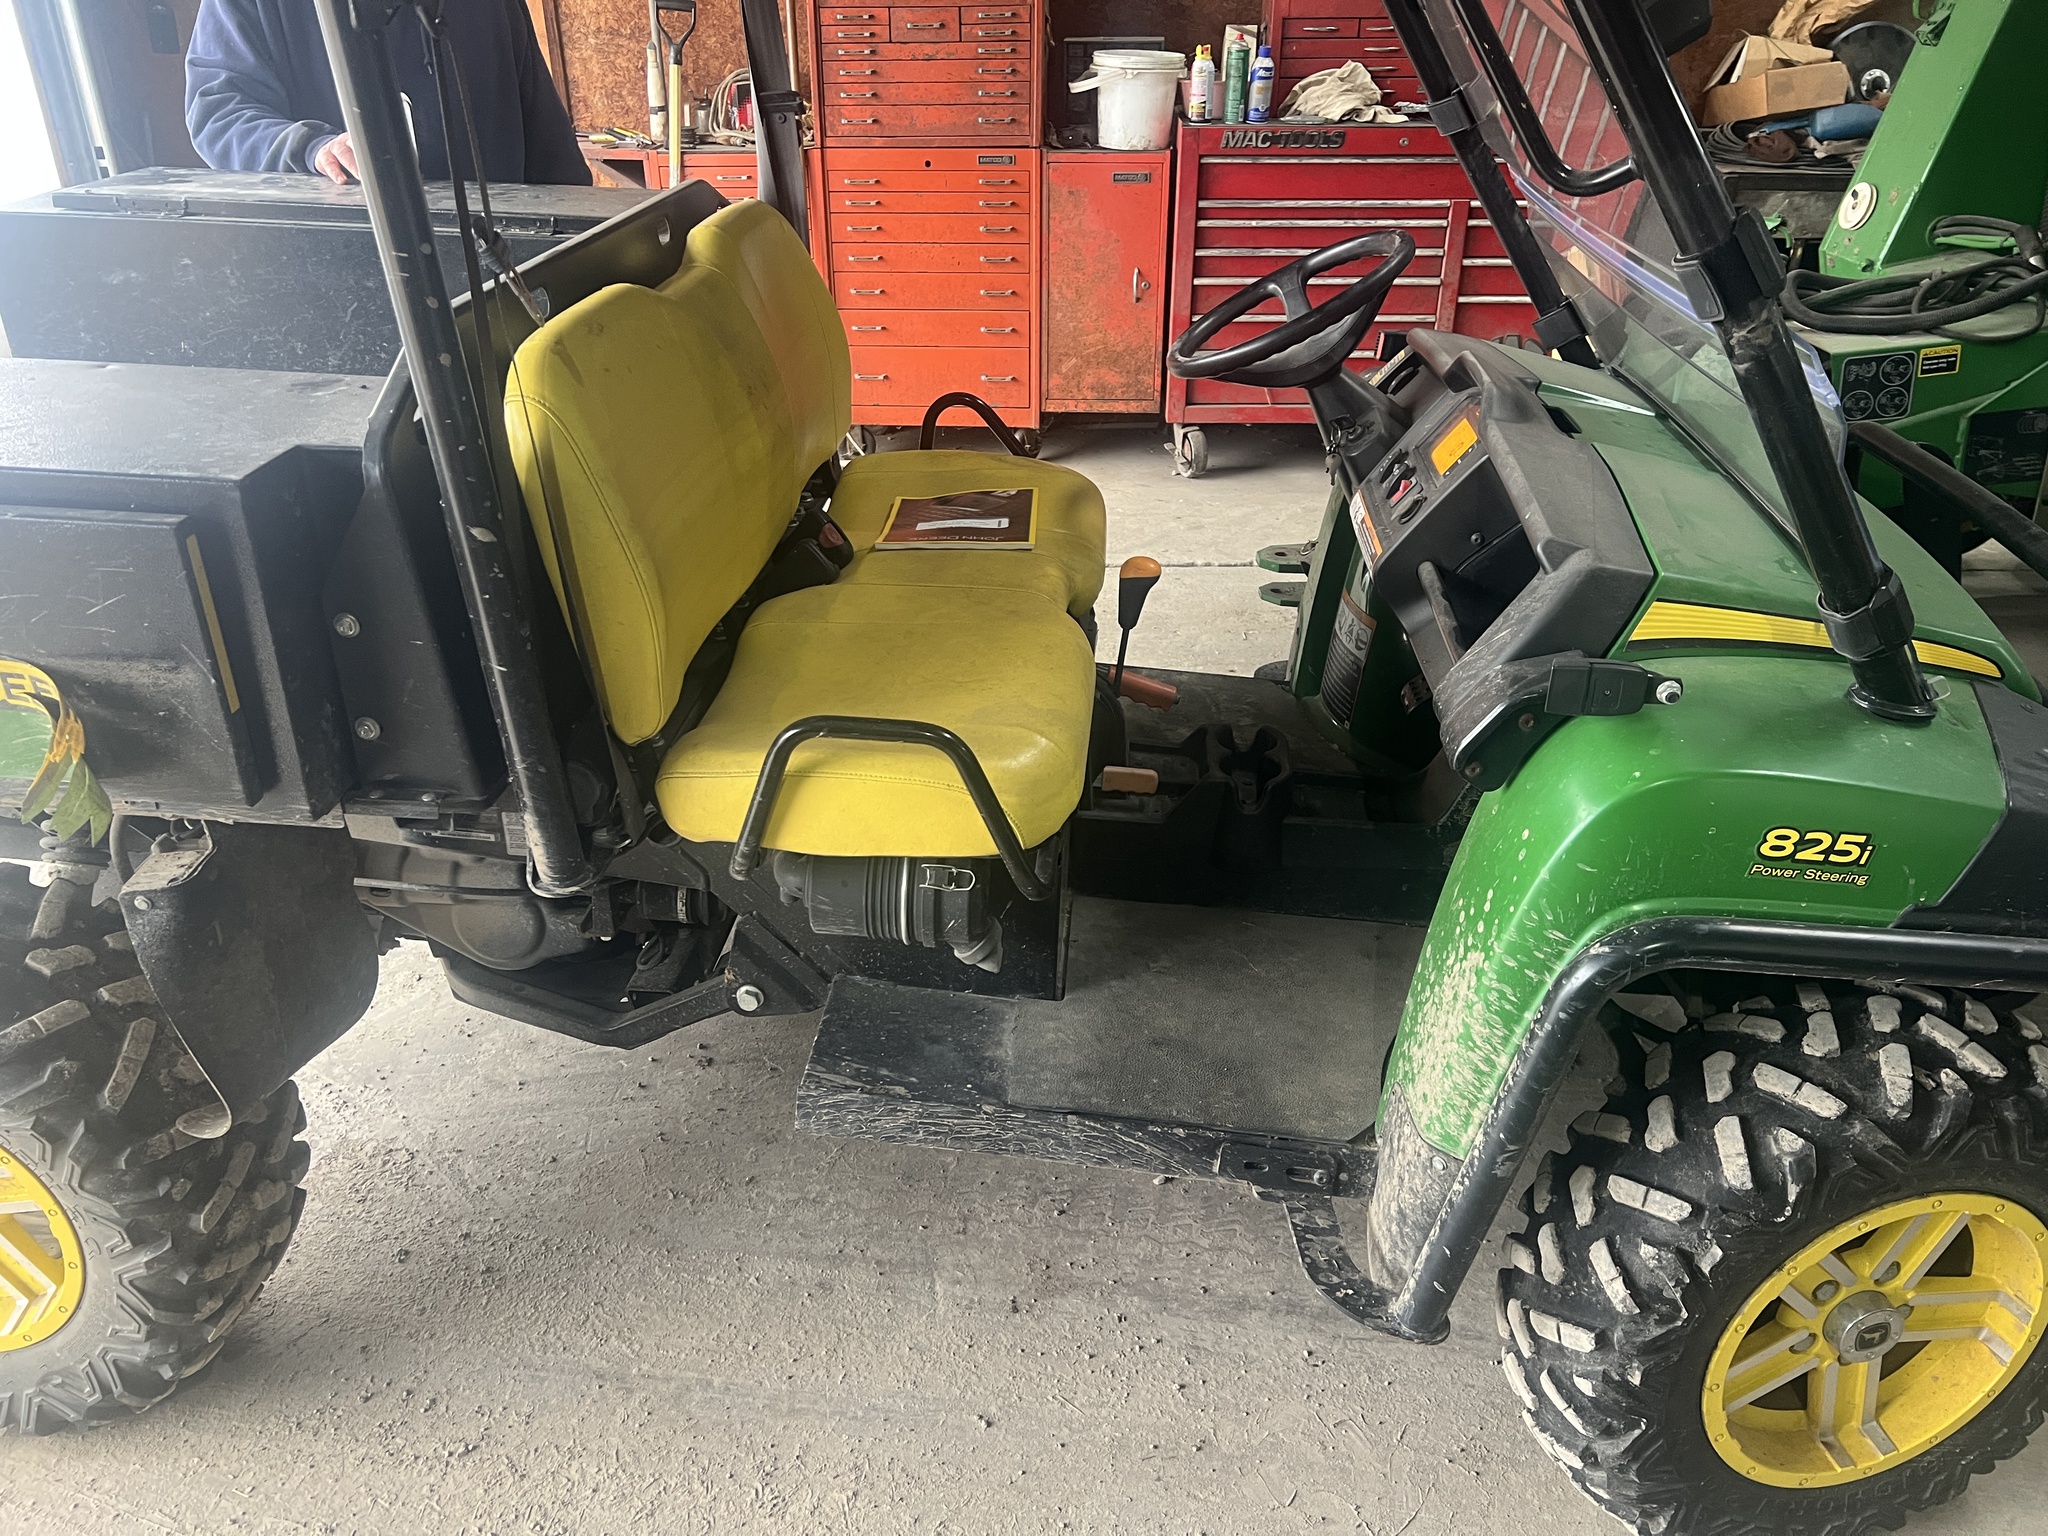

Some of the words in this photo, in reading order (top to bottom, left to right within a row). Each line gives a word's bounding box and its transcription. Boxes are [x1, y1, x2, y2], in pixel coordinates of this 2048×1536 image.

[1221, 130, 1273, 149] MAC
[1277, 129, 1347, 149] TOOLS
[1759, 828, 1873, 865] 825i
[1750, 864, 1801, 879] Power
[1803, 868, 1870, 887] Steering
